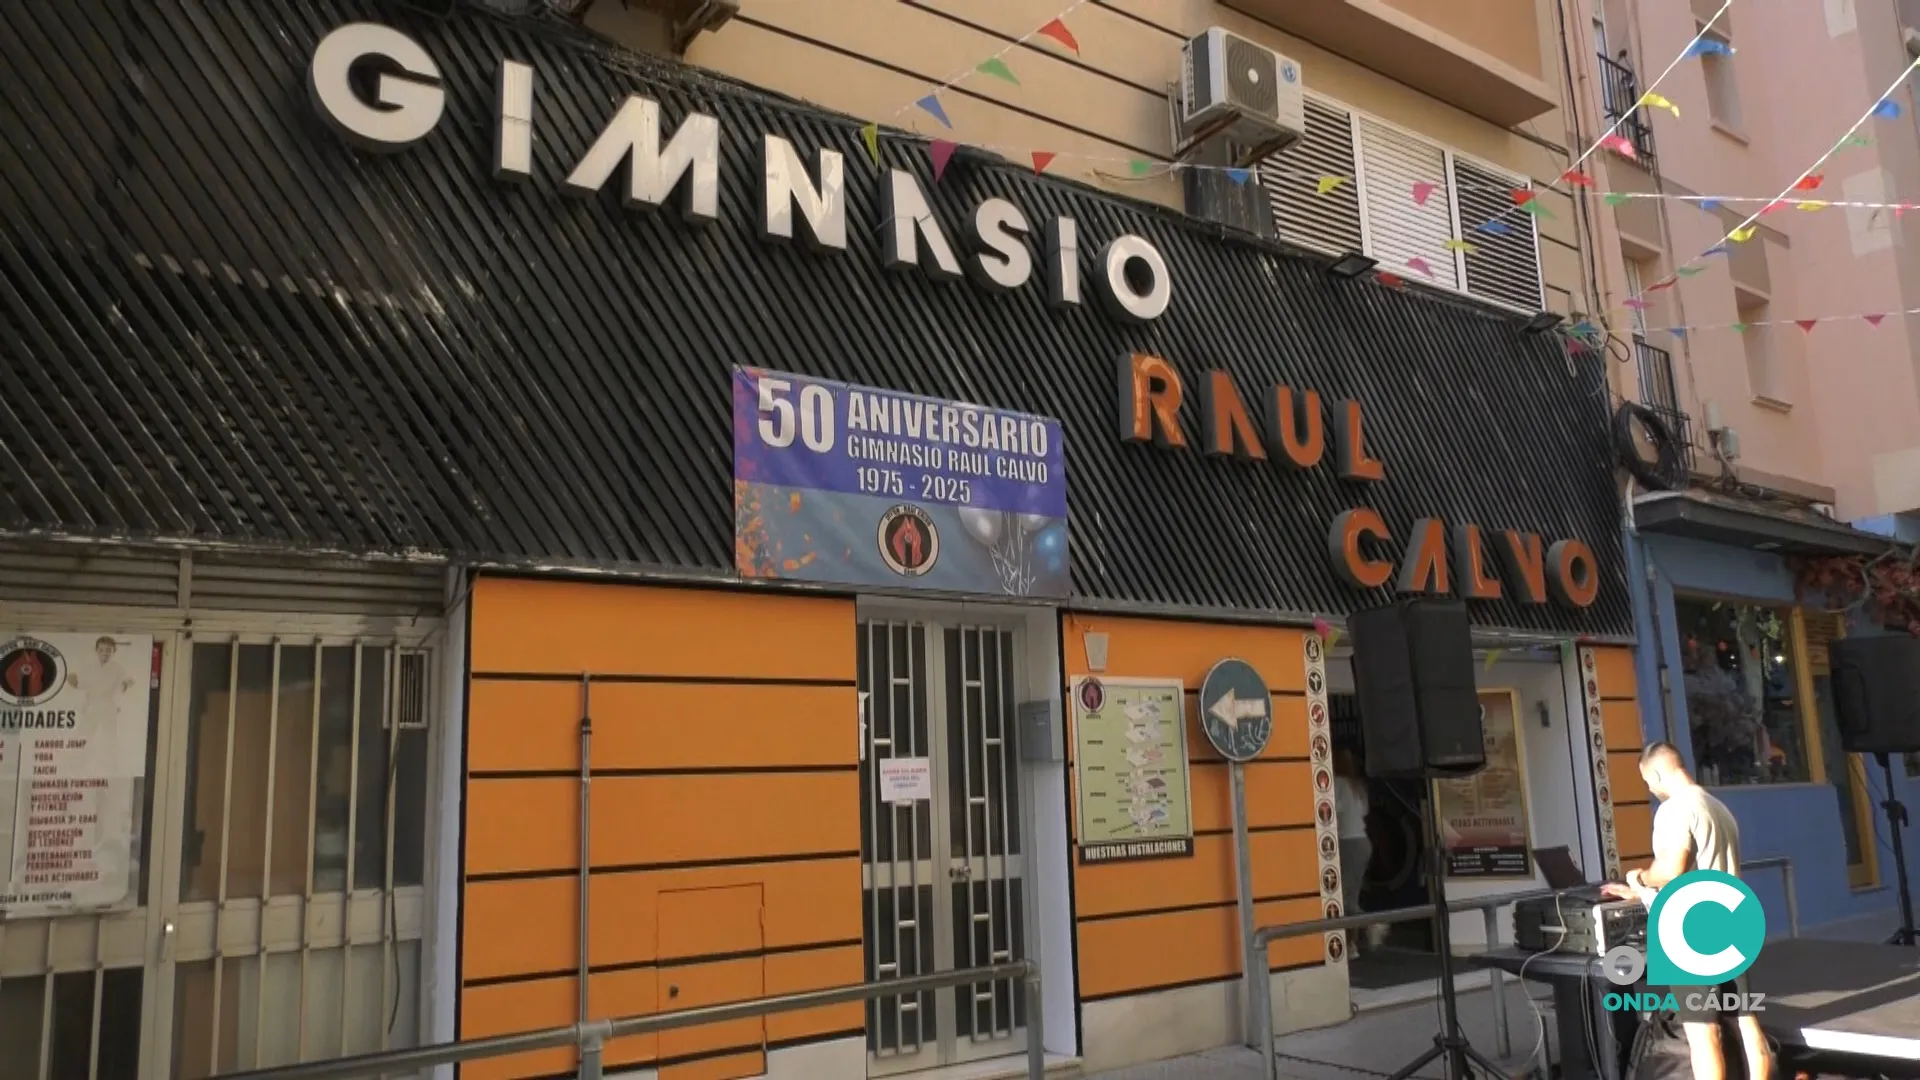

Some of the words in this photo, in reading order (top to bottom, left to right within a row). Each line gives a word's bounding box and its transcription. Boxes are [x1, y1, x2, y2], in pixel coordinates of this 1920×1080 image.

[308, 22, 1171, 319] GIMNASIO
[757, 377, 835, 453] 50
[848, 391, 1048, 458] ANIVERSARIO
[1125, 353, 1384, 480] RAUL
[847, 434, 942, 470] GIMNASIO
[948, 449, 991, 477] RAUL
[996, 455, 1048, 485] CALVO
[857, 466, 903, 496] 1975
[922, 473, 971, 504] 2025
[1334, 507, 1598, 608] CALVO
[0, 709, 76, 730] IVIDADES
[34, 752, 53, 761] YOGA
[1085, 844, 1127, 861] NUESTRAS
[1128, 840, 1187, 856] INSTALACIONES
